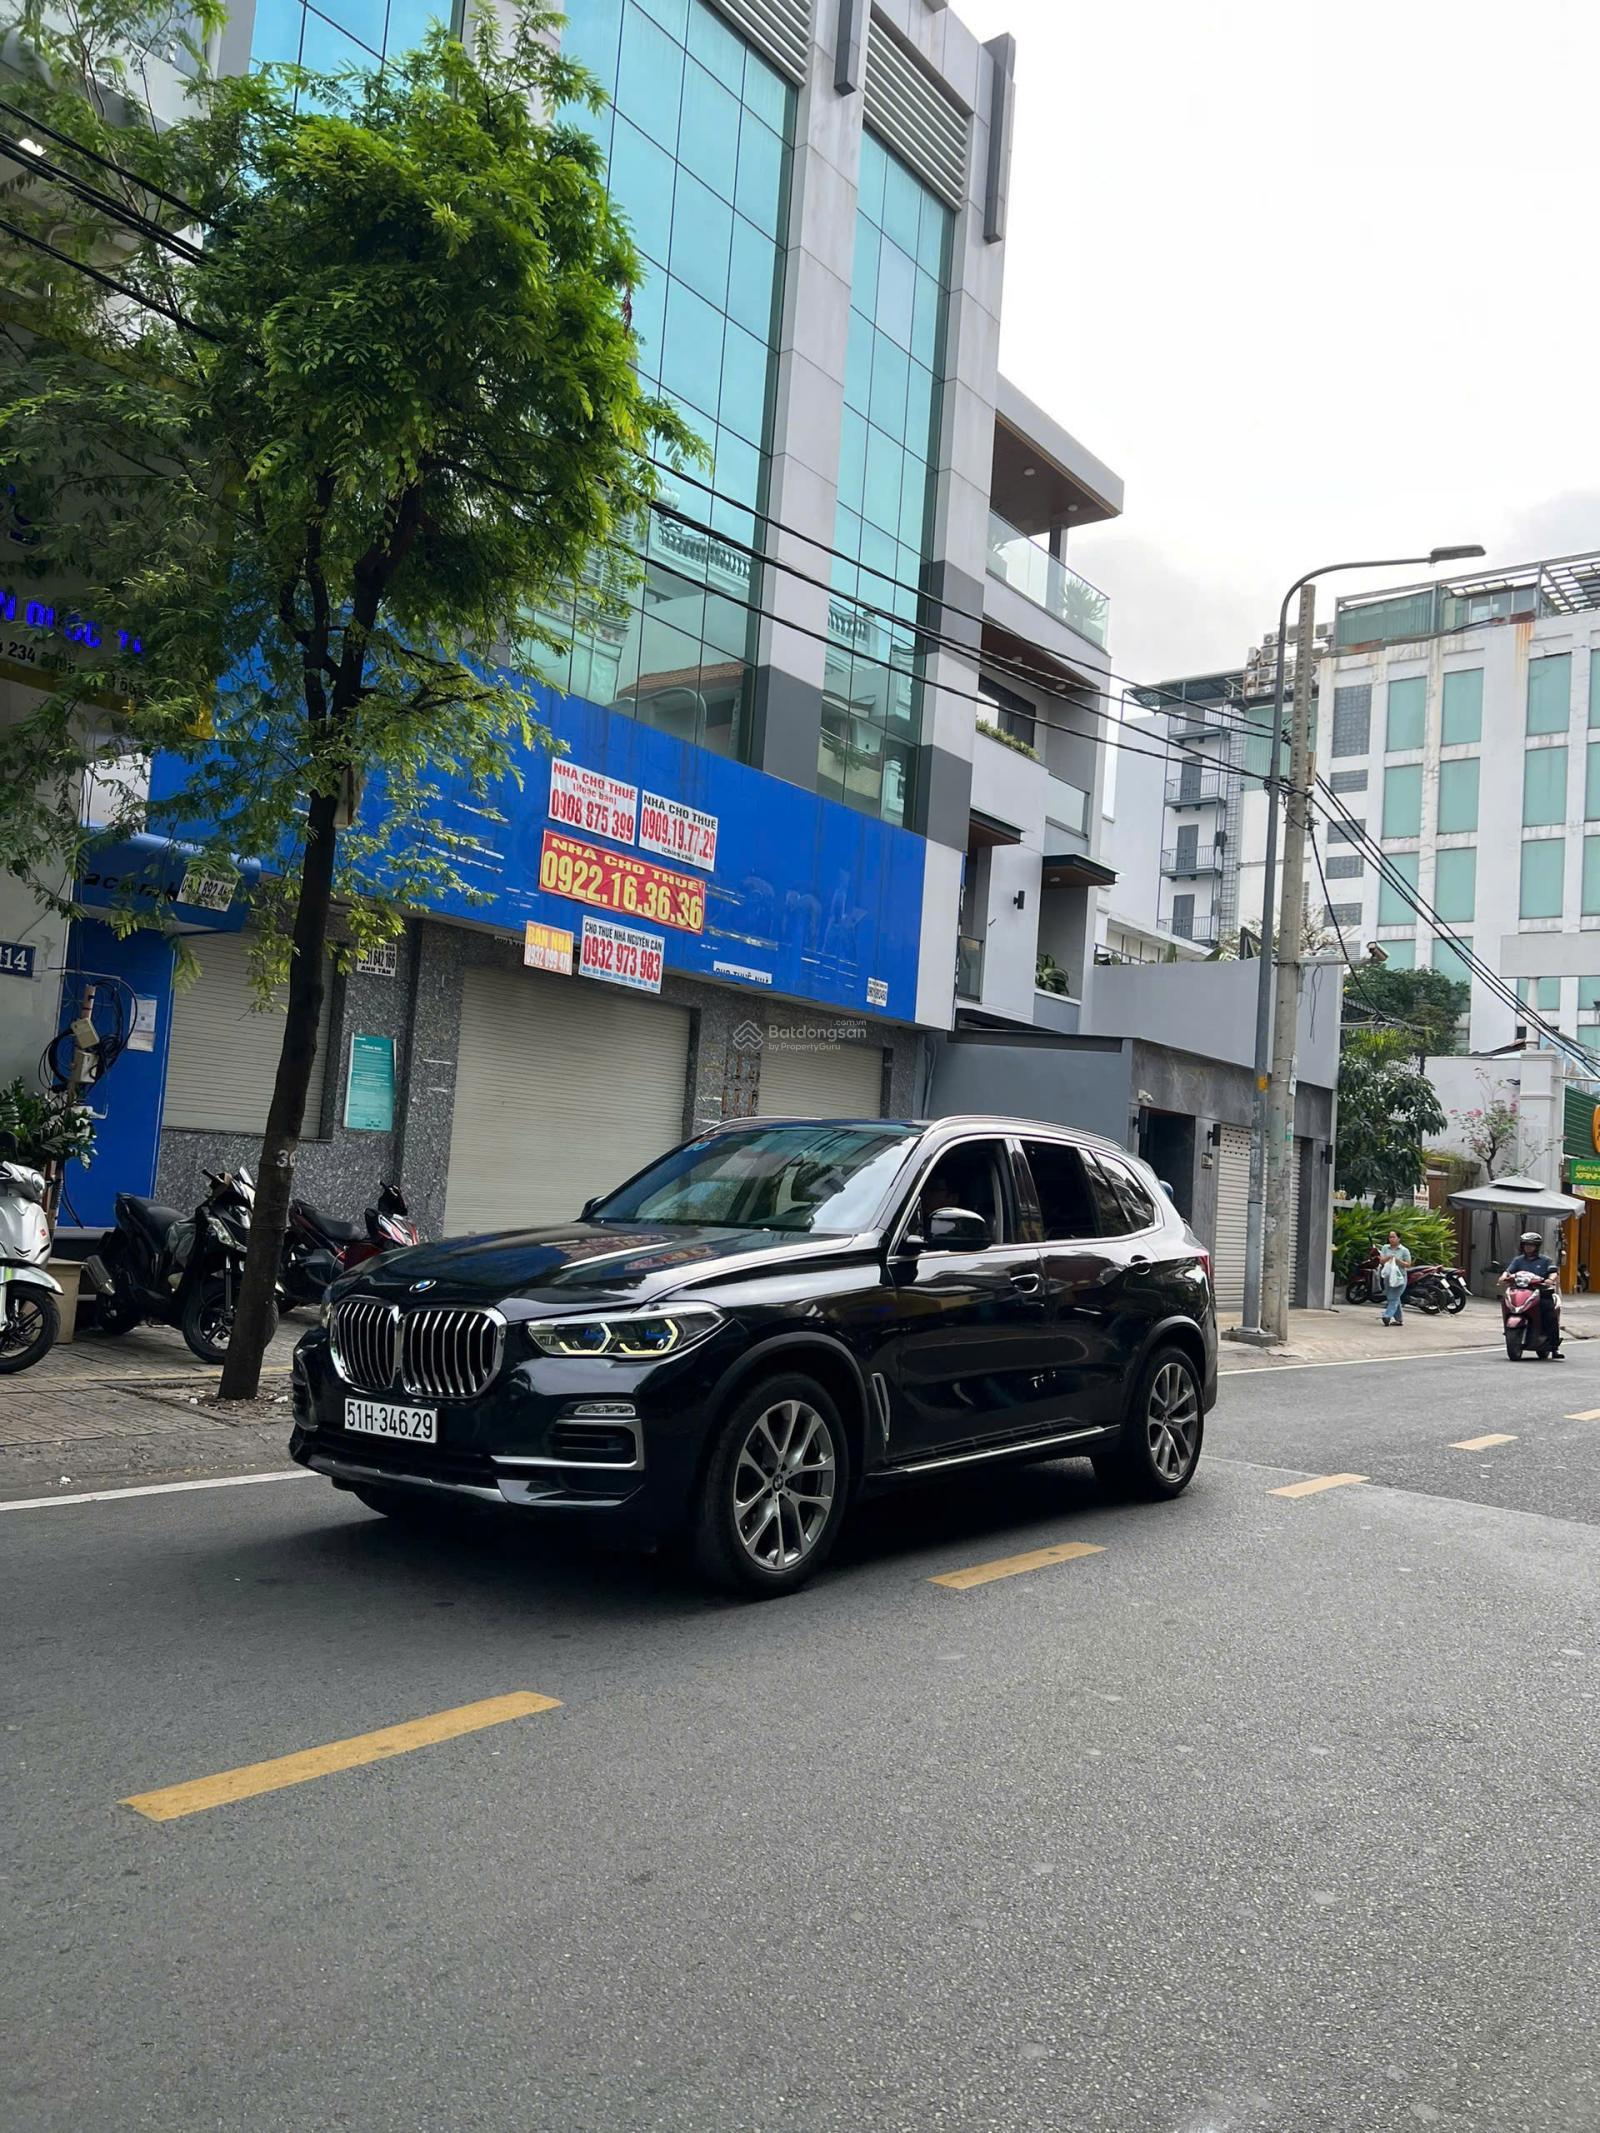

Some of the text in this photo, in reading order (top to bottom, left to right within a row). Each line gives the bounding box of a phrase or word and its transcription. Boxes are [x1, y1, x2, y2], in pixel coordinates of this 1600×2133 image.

[582, 773, 604, 790] CHO
[608, 782, 636, 801] THUÊ
[551, 788, 635, 841] 0908 875 399
[641, 807, 716, 861] 0909.19.77.29
[668, 804, 689, 819] CHO
[692, 812, 717, 830] THUÊ
[551, 838, 699, 892] NHÀ CHO THUÊ
[542, 850, 703, 930] 0922.16.36.36
[585, 922, 598, 934] CHO
[598, 925, 613, 939] THUÊ
[583, 935, 613, 970] 0932
[616, 943, 637, 977] 973
[640, 949, 661, 982] 983
[347, 1401, 433, 1440] 51H-346.29
